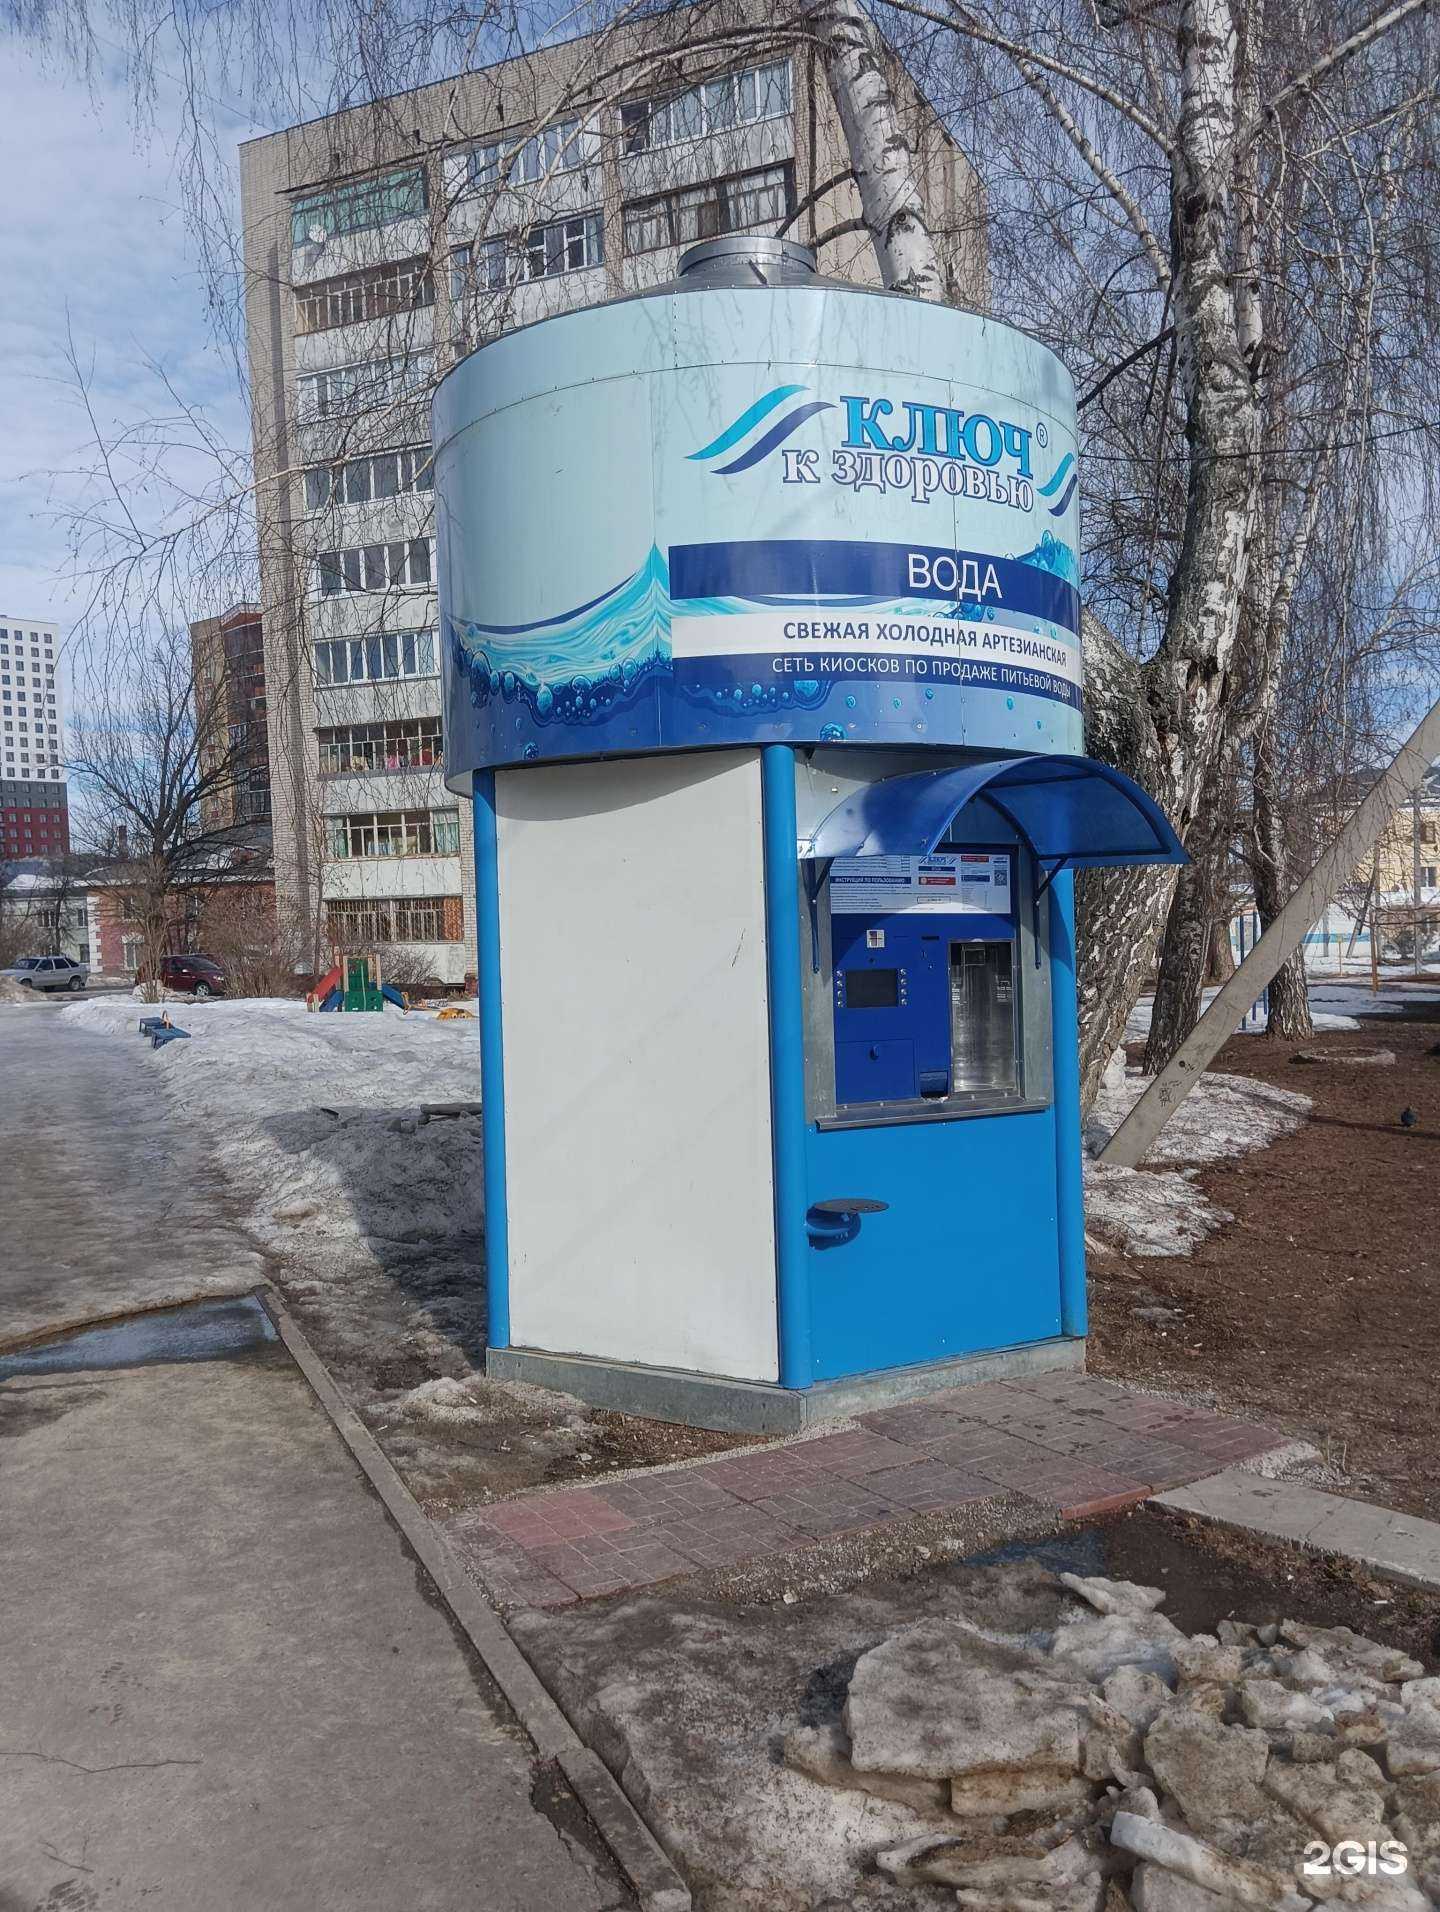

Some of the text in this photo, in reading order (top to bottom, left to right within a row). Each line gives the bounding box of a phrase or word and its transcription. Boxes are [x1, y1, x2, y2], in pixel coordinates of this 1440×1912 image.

[840, 396, 1034, 479] КЛЮЧ
[908, 553, 1003, 602] ВОДА
[783, 622, 1067, 667] СВЕЖАЯ ХОЛОДНАЯ АРТЕЗИАНСКАЯ
[772, 657, 1072, 699] СЕТЬ КИОСКОВ ПО ПРОДАЖЕ ПИТЬЕВОЙ ВОДЫ
